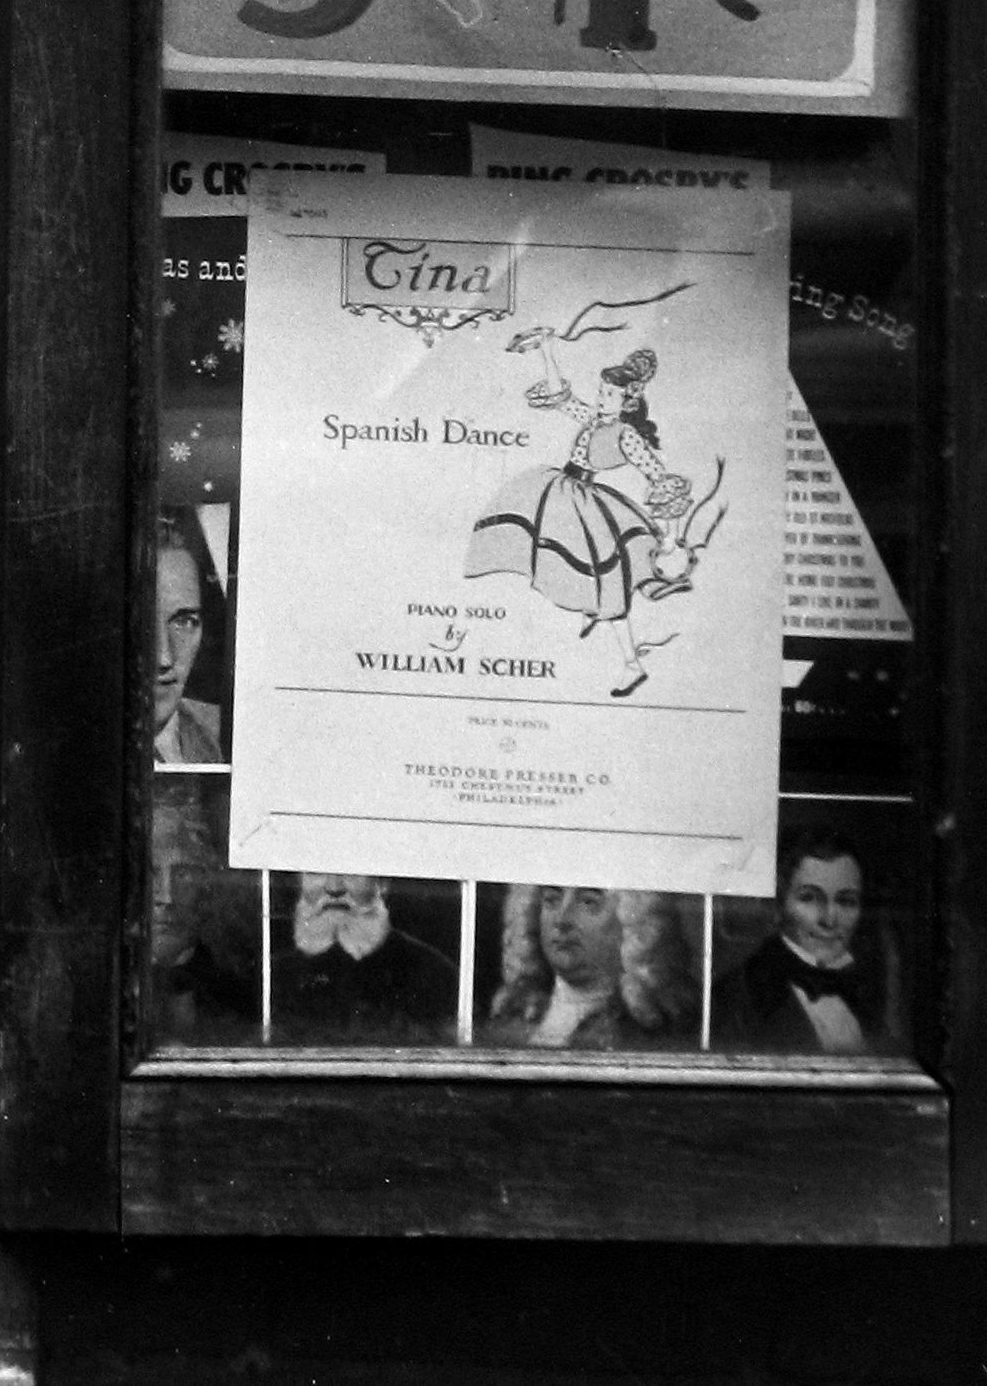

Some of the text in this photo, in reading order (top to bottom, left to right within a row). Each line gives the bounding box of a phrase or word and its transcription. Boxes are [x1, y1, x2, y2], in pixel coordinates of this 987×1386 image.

[363, 240, 493, 294] Tina
[322, 413, 532, 450] Spanish Dance
[406, 602, 508, 620] PIANO SOLO
[428, 623, 470, 652] by
[354, 650, 558, 679] WILLIAM SCHER
[403, 763, 499, 781] THEODORE
